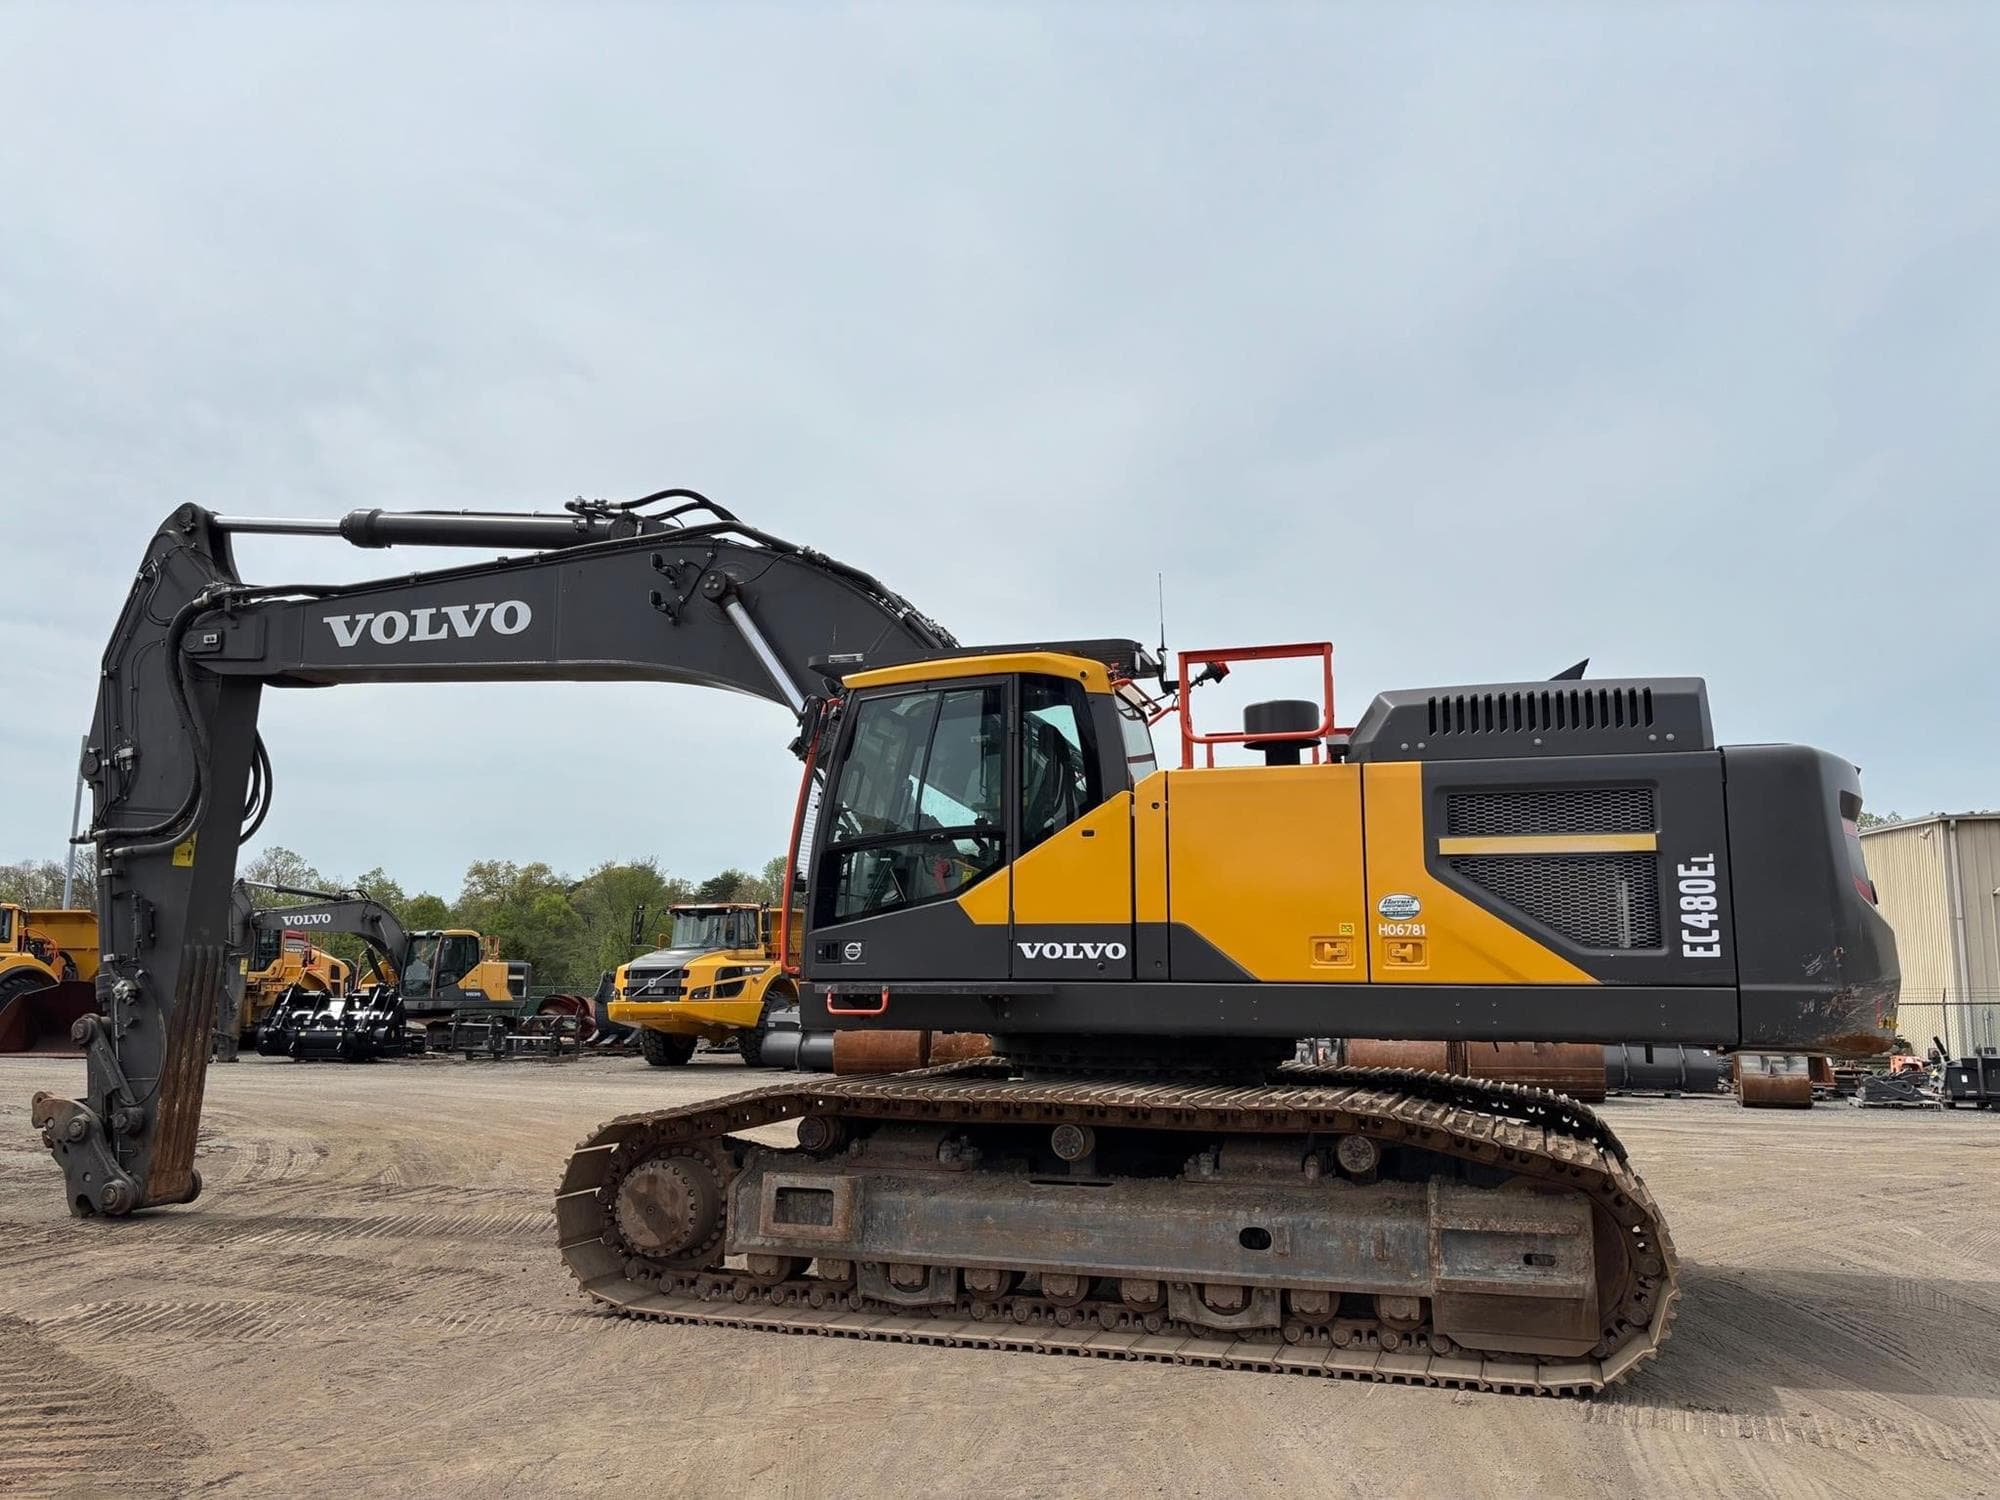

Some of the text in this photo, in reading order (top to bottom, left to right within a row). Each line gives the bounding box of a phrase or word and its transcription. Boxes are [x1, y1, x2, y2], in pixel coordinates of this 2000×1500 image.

[323, 600, 532, 648] VOLVO
[1677, 853, 1721, 957] EC480EL
[281, 913, 331, 926] VOLVO
[1378, 923, 1426, 936] H06781
[1017, 942, 1127, 960] VOLVO
